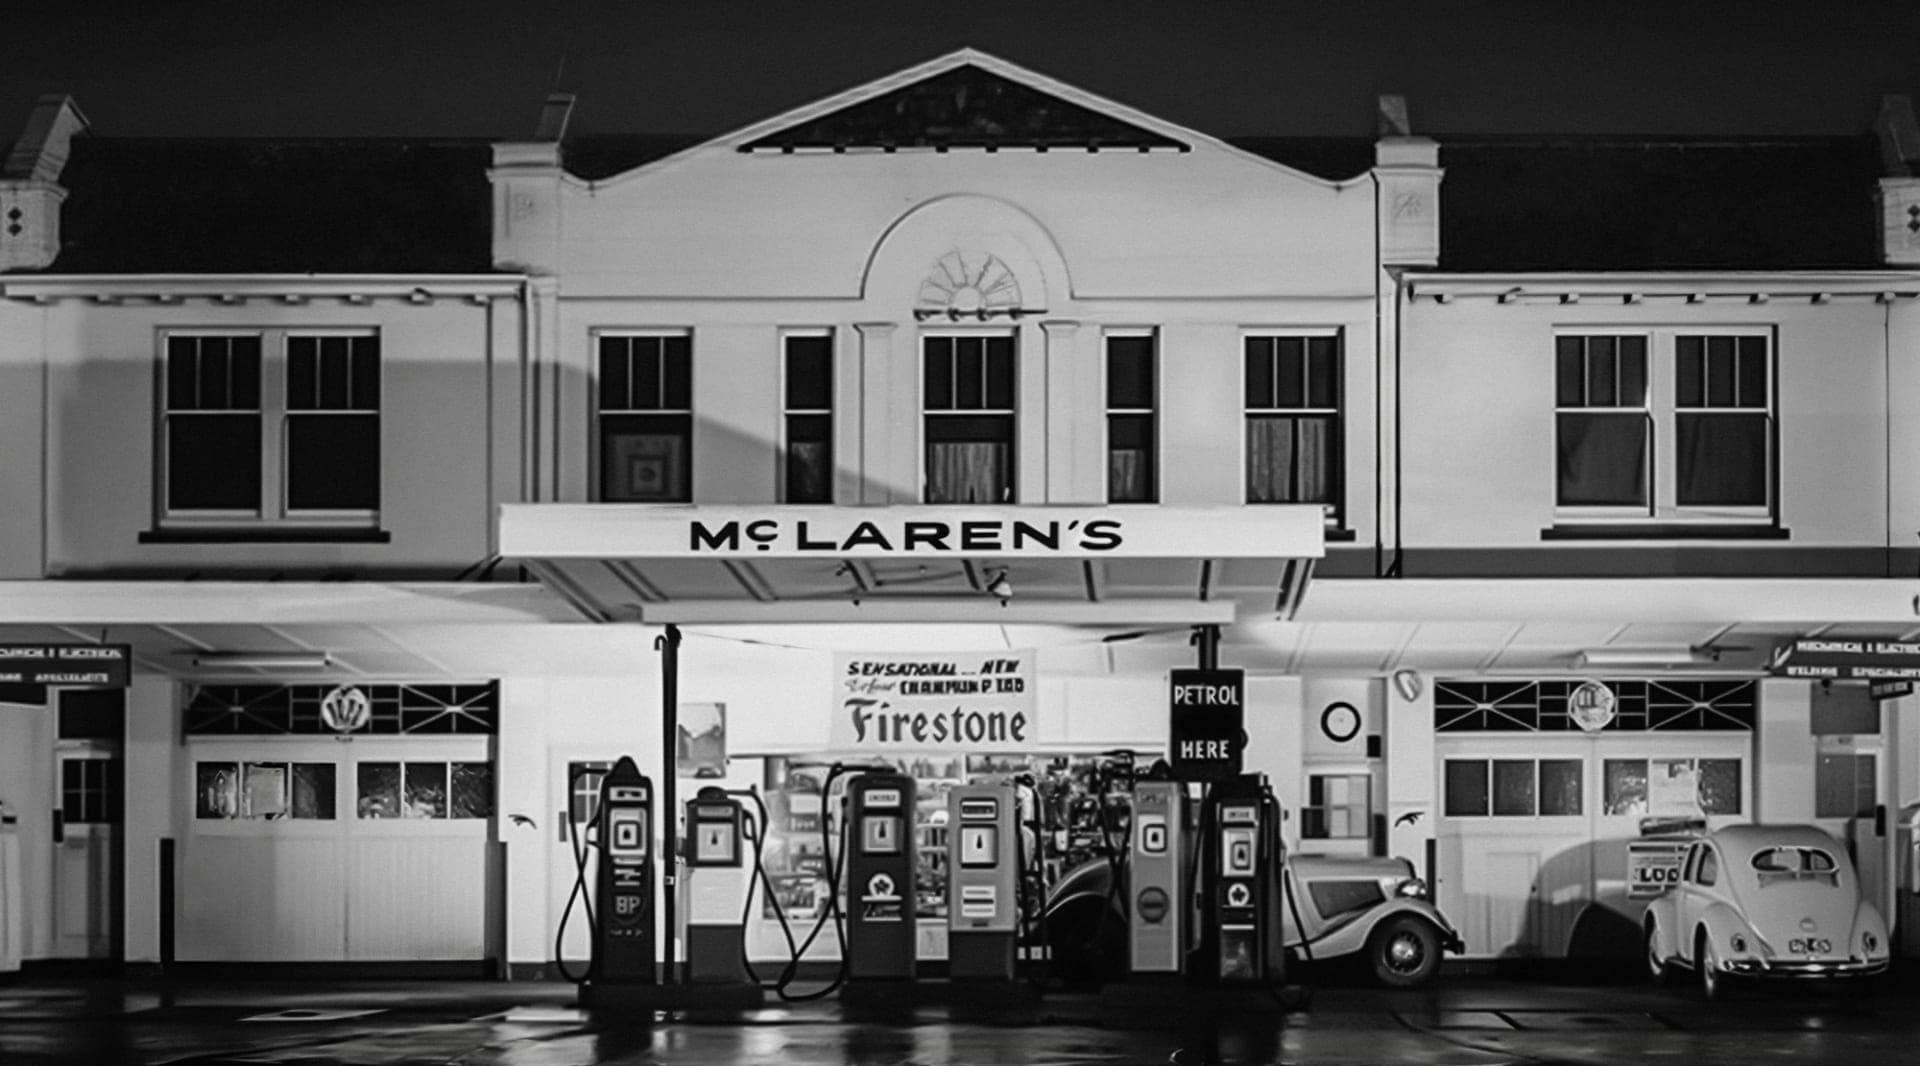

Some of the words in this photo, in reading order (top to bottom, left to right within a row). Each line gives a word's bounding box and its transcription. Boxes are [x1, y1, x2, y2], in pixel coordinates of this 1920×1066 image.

[848, 661, 956, 676] SENSATIONAL
[980, 659, 1020, 674] NEW
[1174, 684, 1239, 705] PETROL
[844, 698, 1026, 743] Firestone
[1181, 740, 1230, 759] HERE
[616, 896, 641, 914] BP
